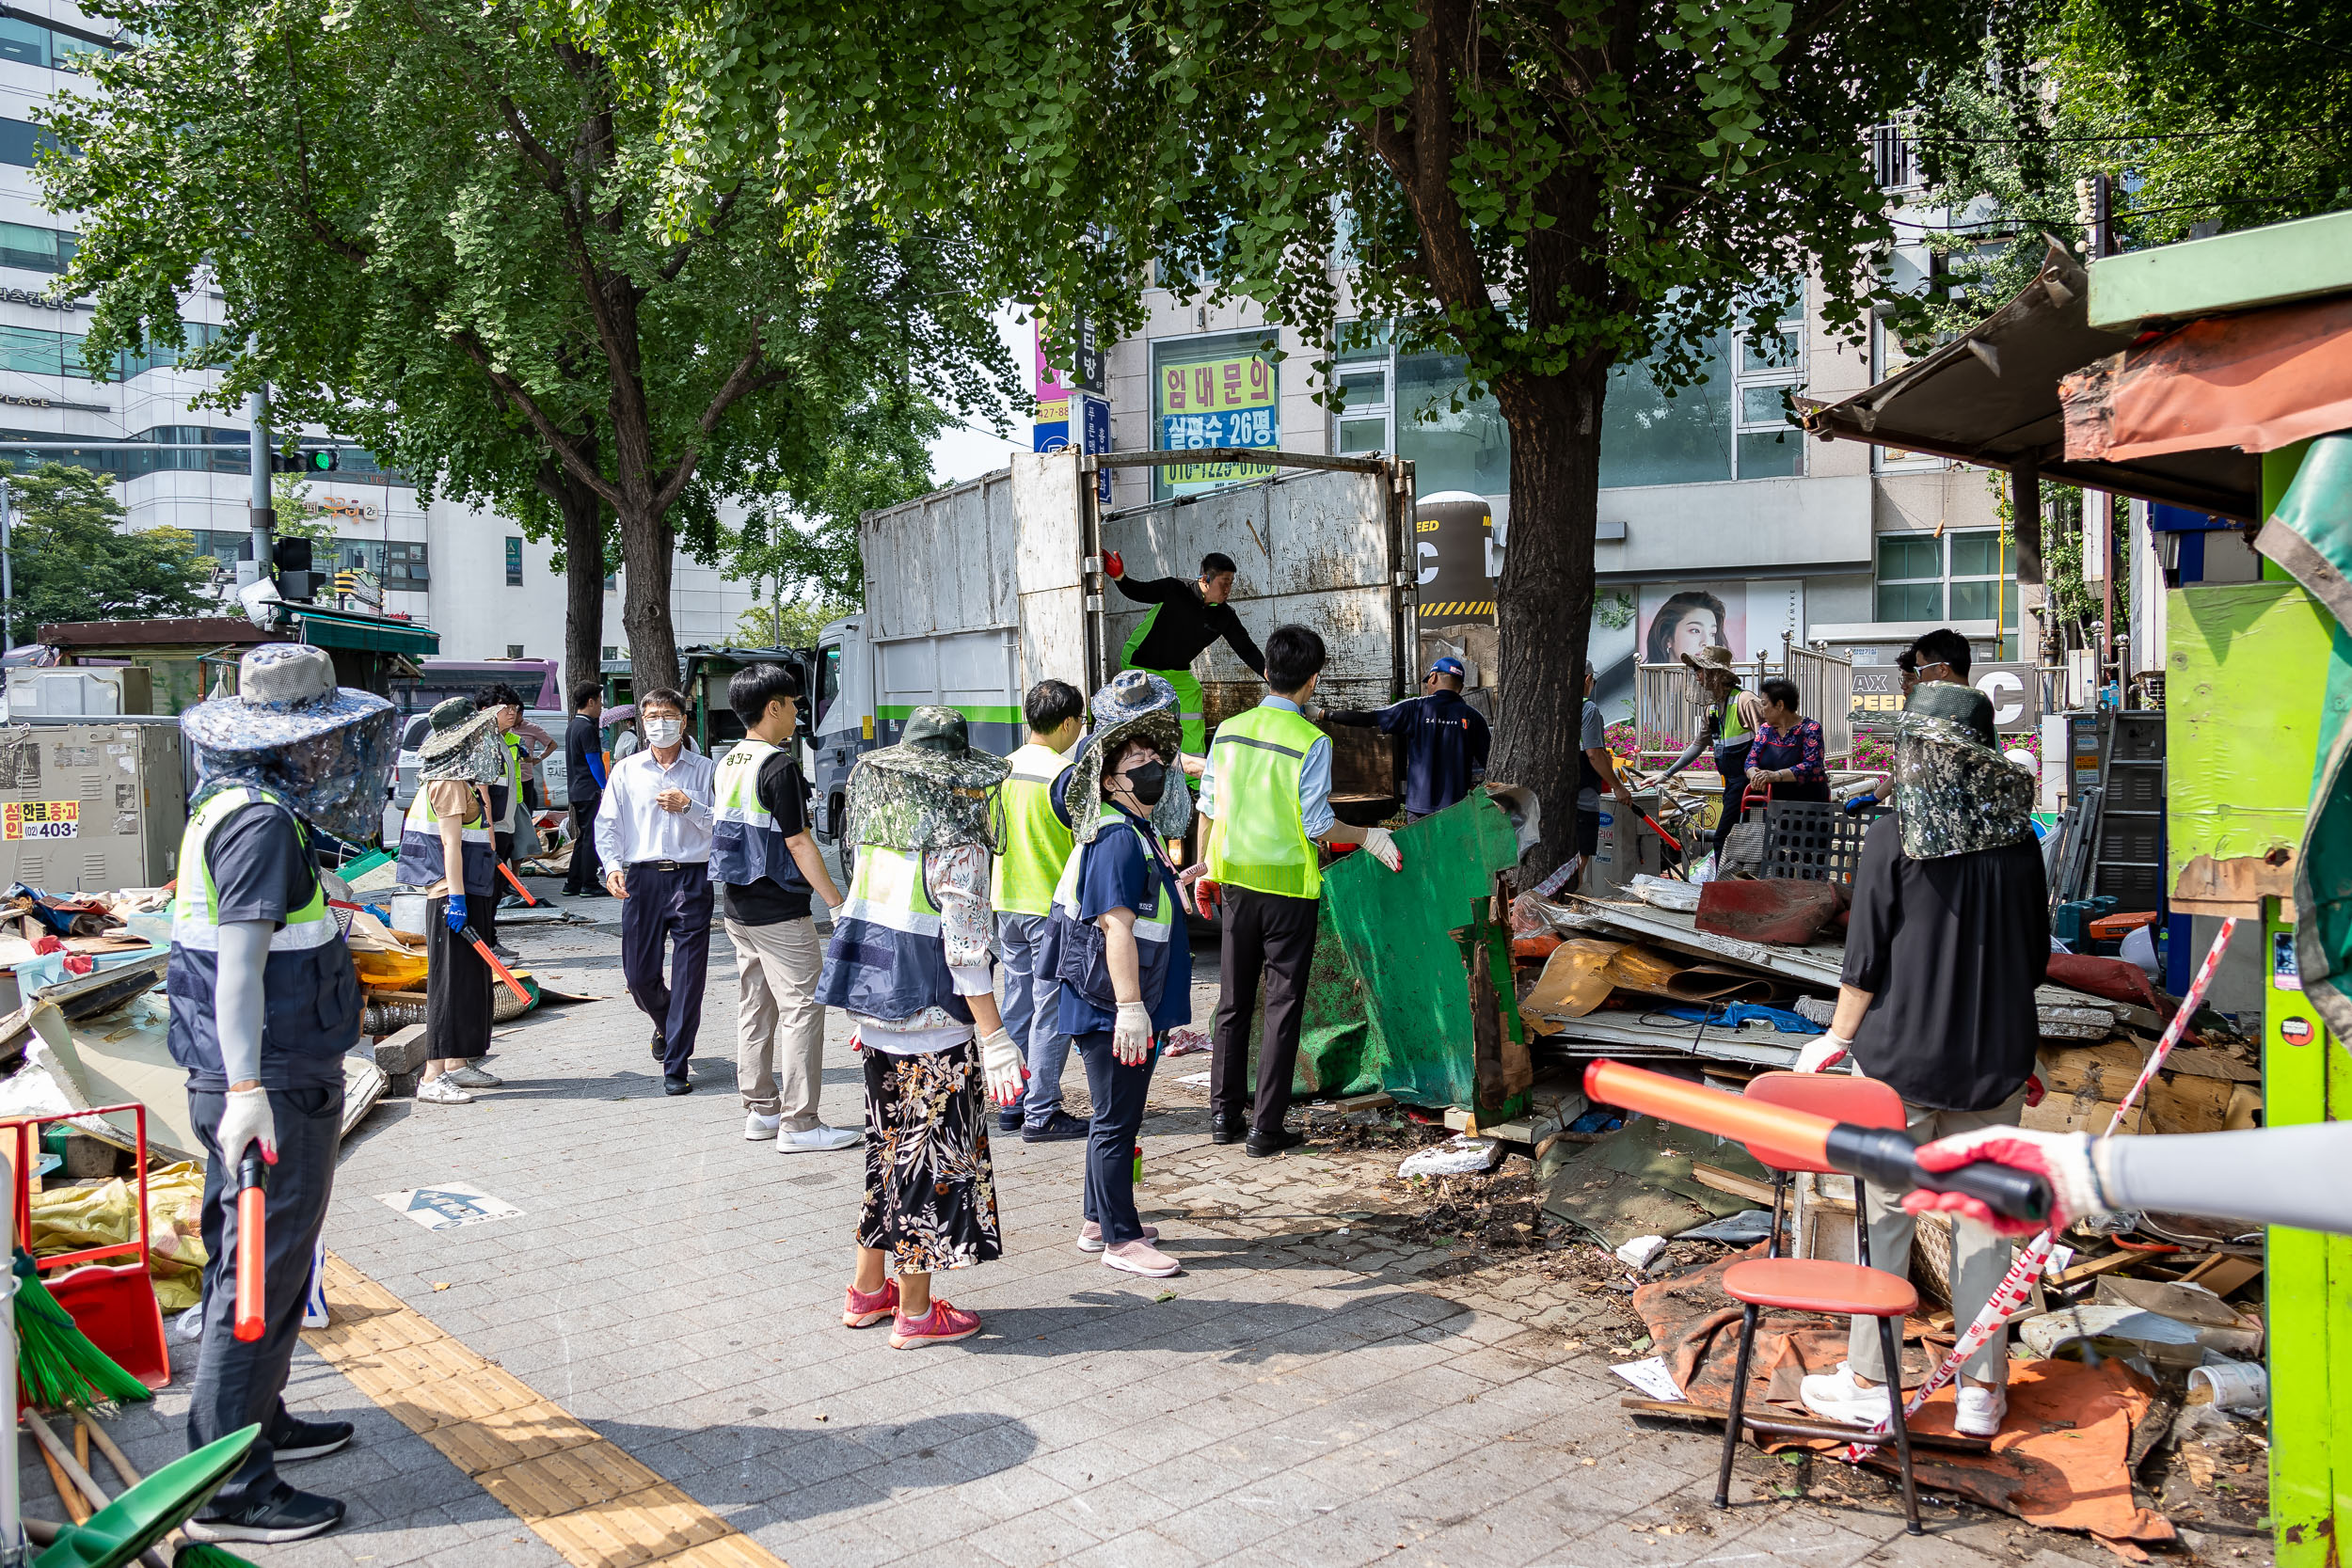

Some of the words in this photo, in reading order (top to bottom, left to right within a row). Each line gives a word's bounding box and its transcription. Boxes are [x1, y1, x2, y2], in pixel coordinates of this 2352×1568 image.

[1168, 360, 1269, 409] 임대문의
[1168, 415, 1223, 450] 실평수
[40, 822, 78, 837] 403-
